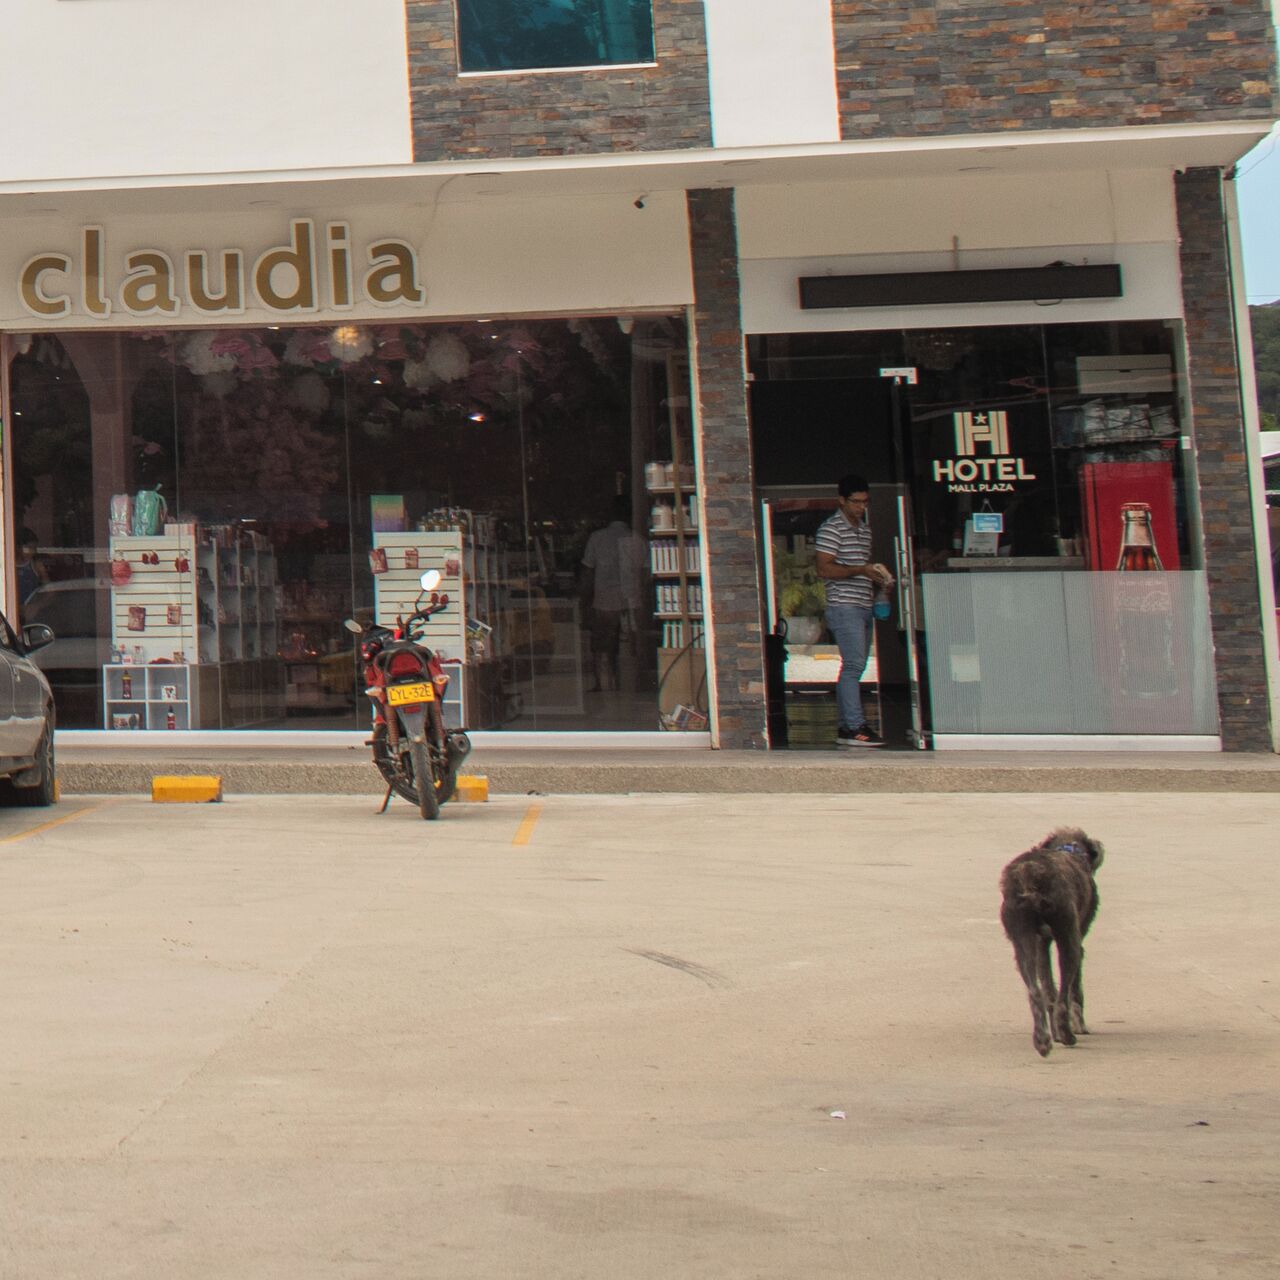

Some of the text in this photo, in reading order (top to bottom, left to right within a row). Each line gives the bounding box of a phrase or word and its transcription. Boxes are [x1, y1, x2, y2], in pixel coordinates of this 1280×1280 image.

[20, 218, 425, 318] claudia
[933, 458, 1037, 482] HOTEL
[948, 483, 1015, 493] MALL PLAZA
